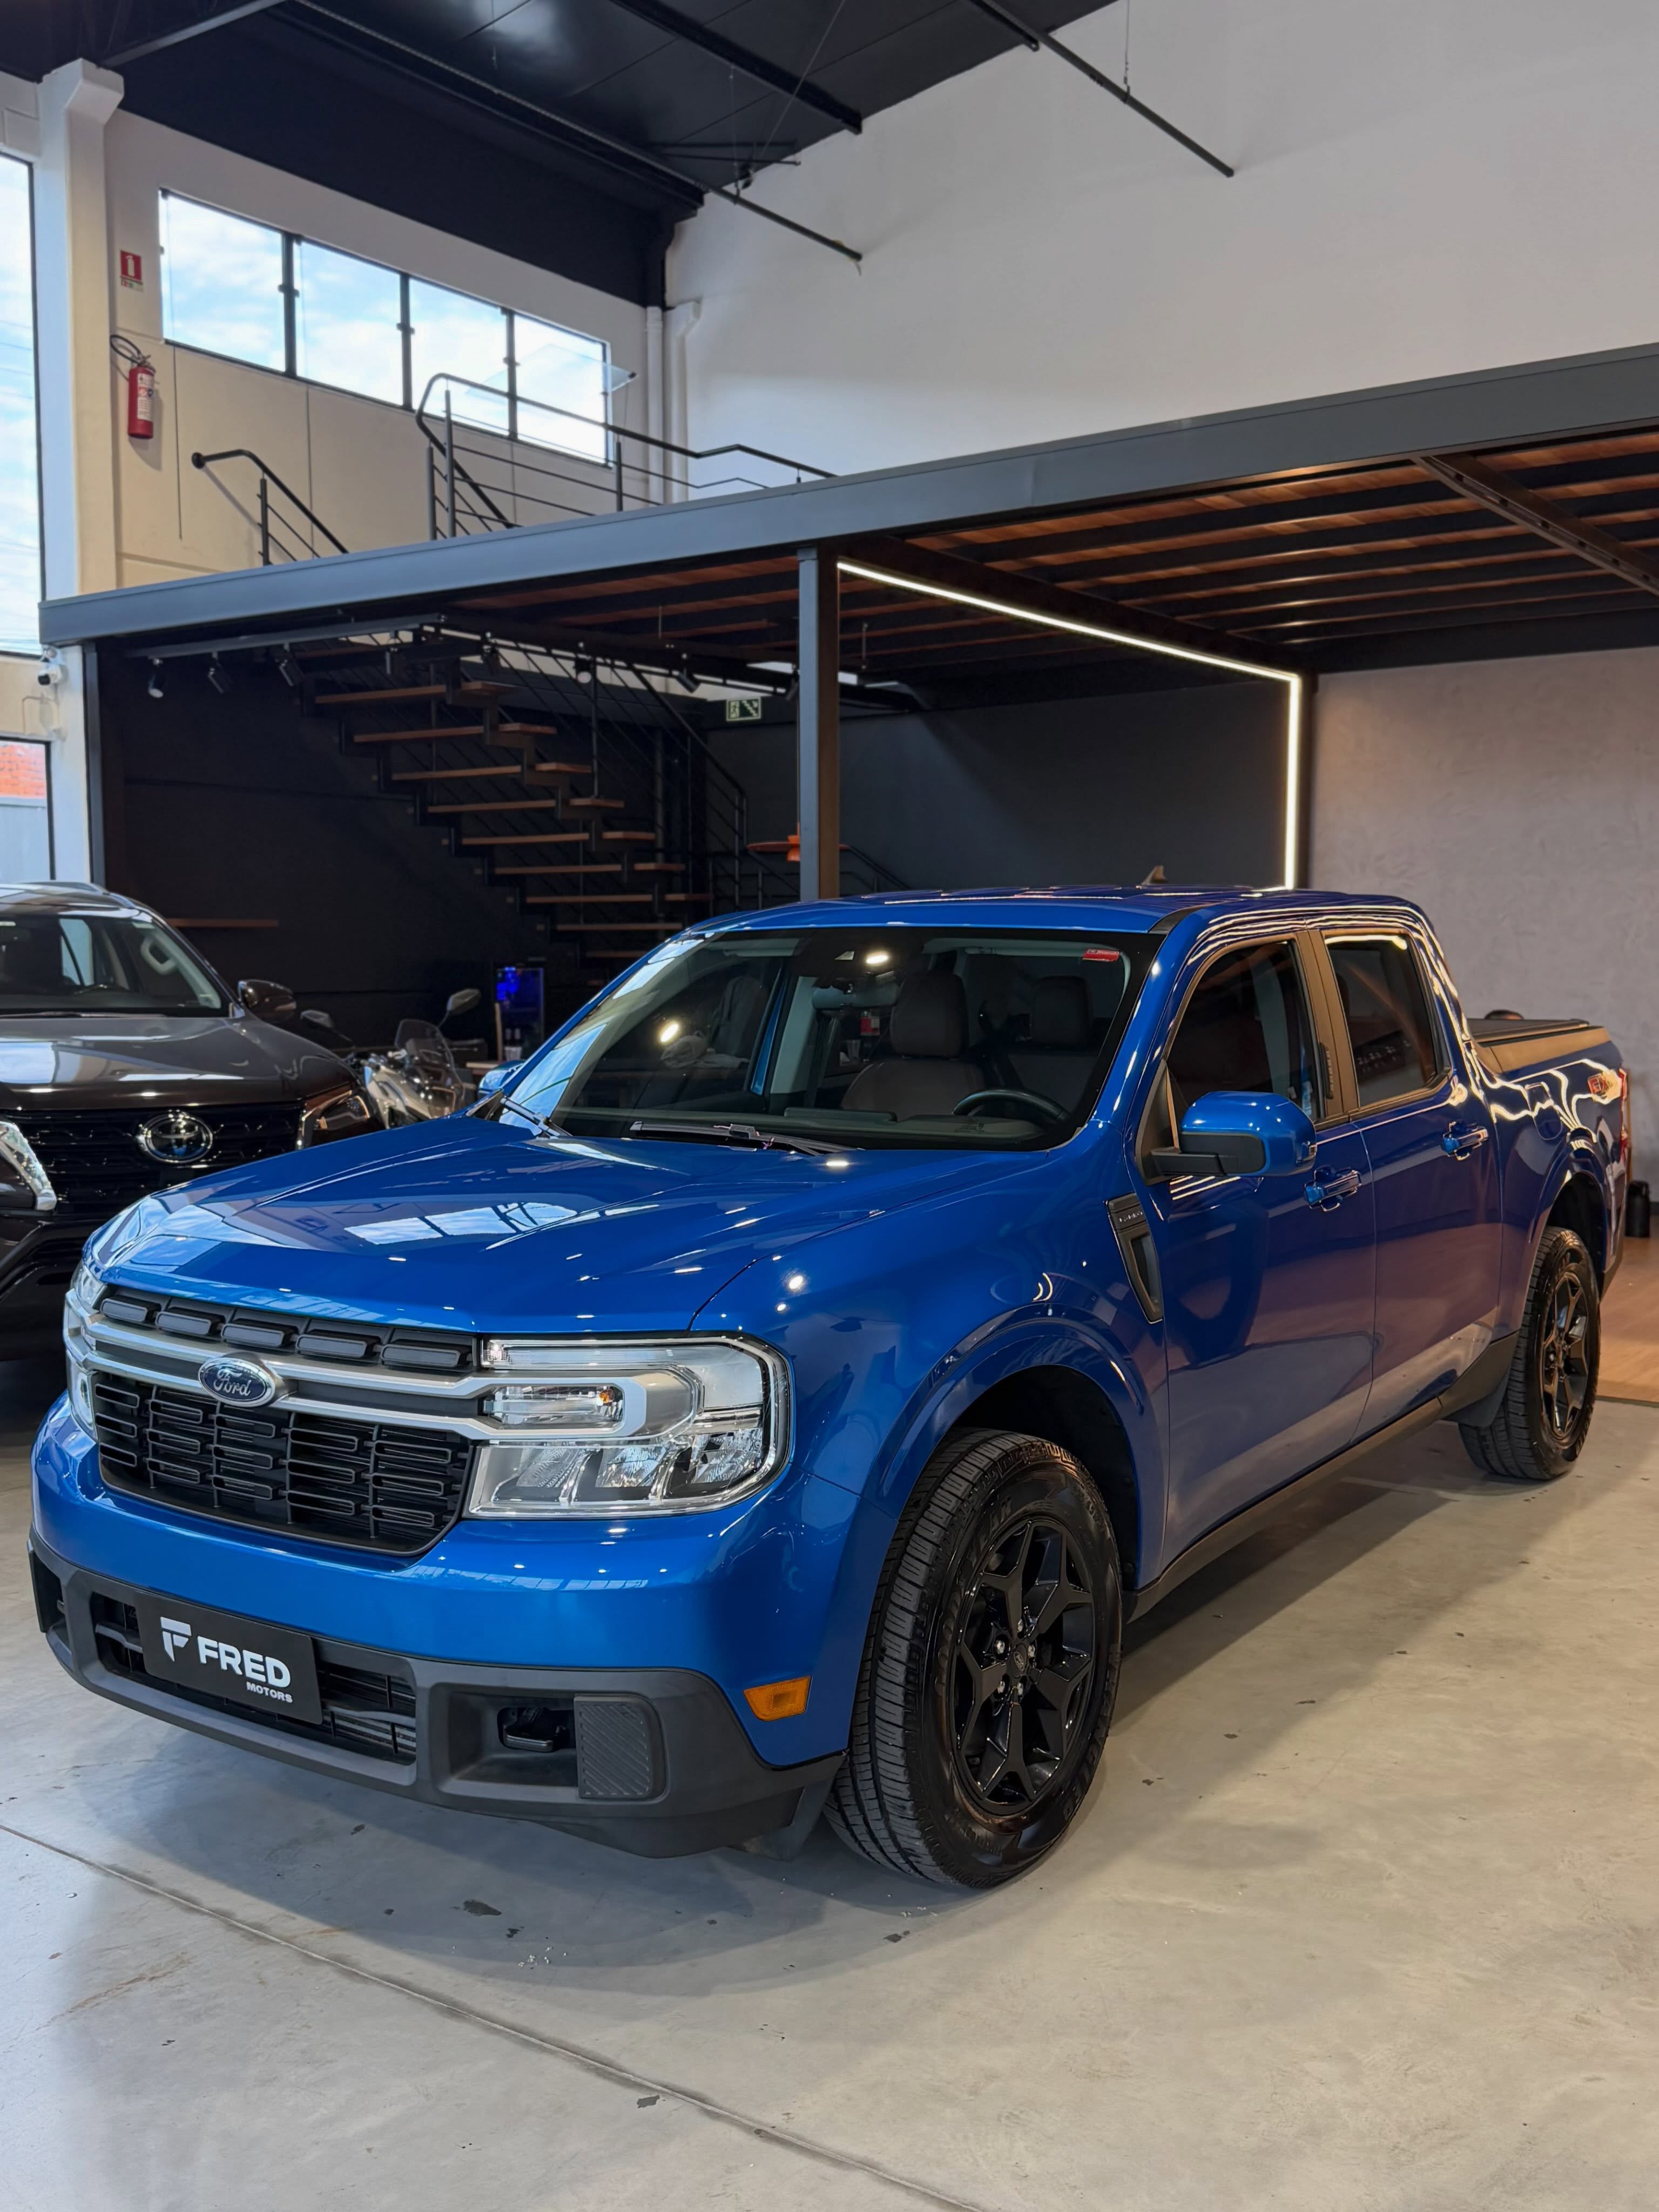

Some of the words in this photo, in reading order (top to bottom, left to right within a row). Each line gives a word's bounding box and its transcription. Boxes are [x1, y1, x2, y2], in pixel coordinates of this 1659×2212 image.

[213, 1368, 252, 1397] Ford
[197, 1636, 291, 1688] FRED
[246, 1681, 293, 1703] MOTORS
